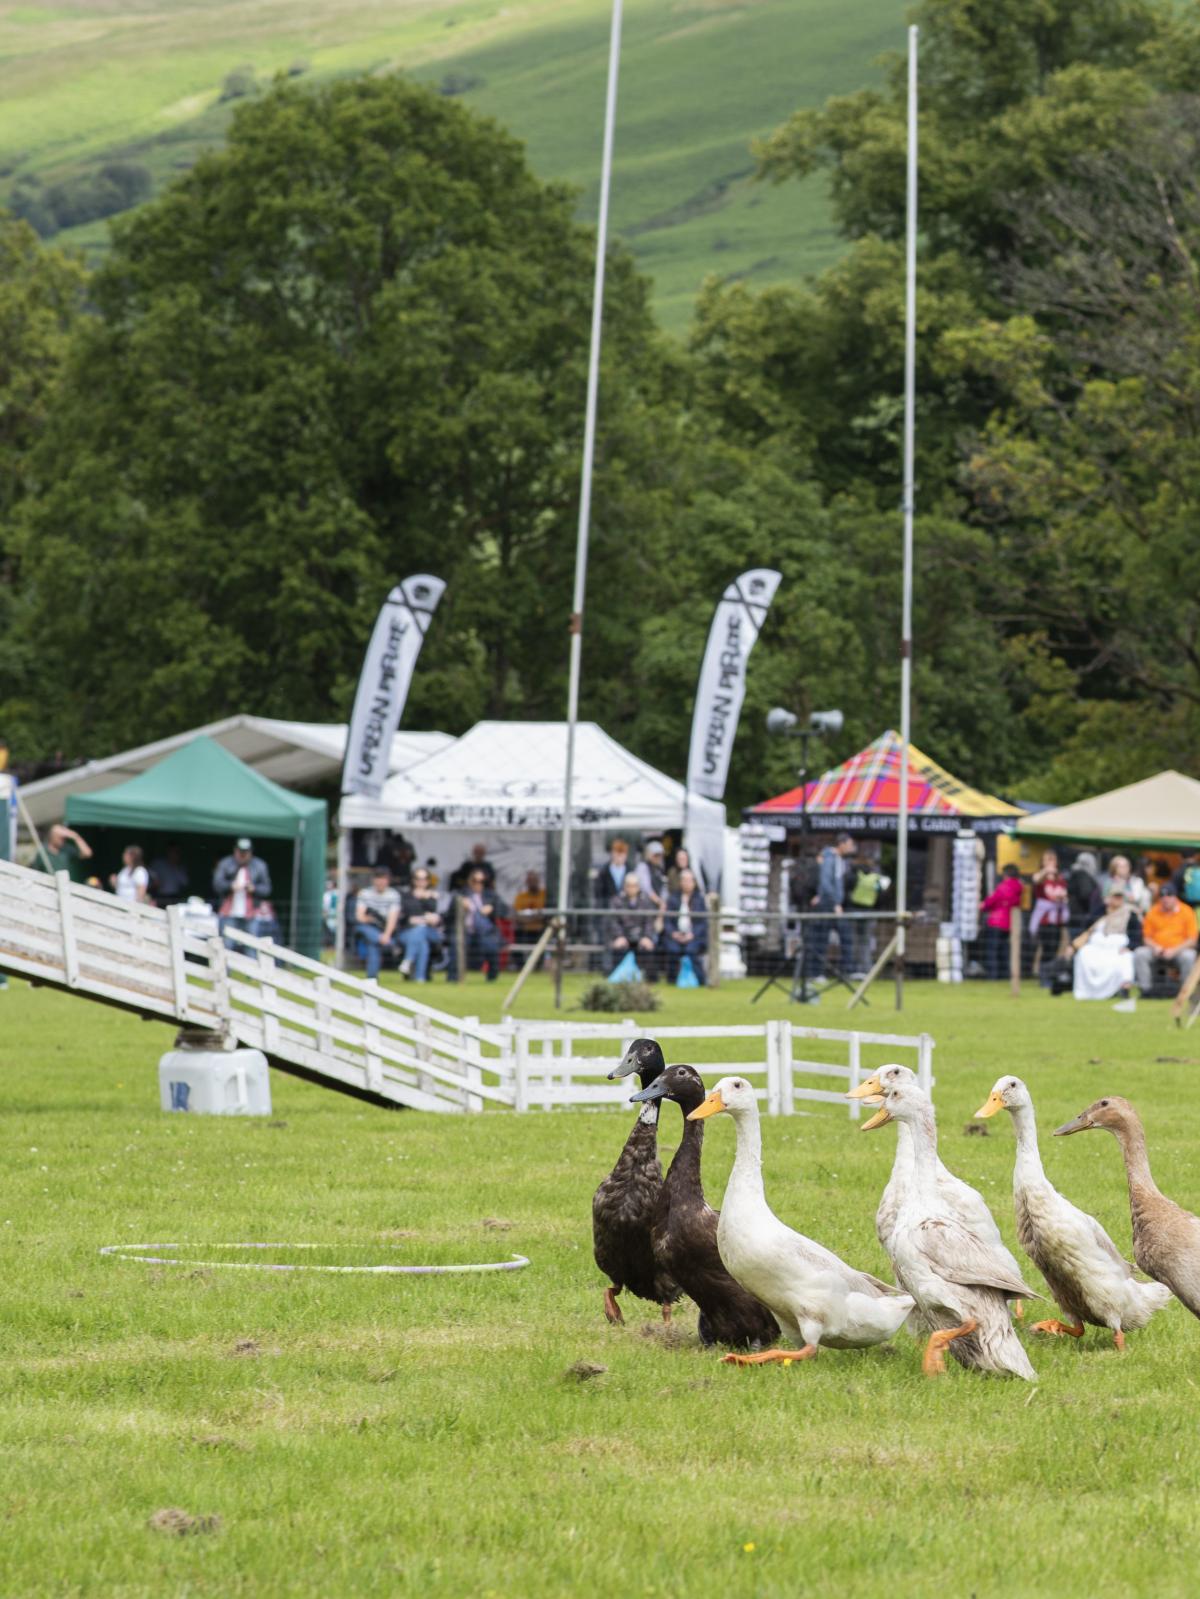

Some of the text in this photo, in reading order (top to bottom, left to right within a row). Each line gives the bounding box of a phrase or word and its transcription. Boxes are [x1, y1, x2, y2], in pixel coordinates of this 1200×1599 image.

[360, 697, 390, 775] URBAN
[703, 695, 732, 774] URBAN
[869, 816, 900, 830] GIFT
